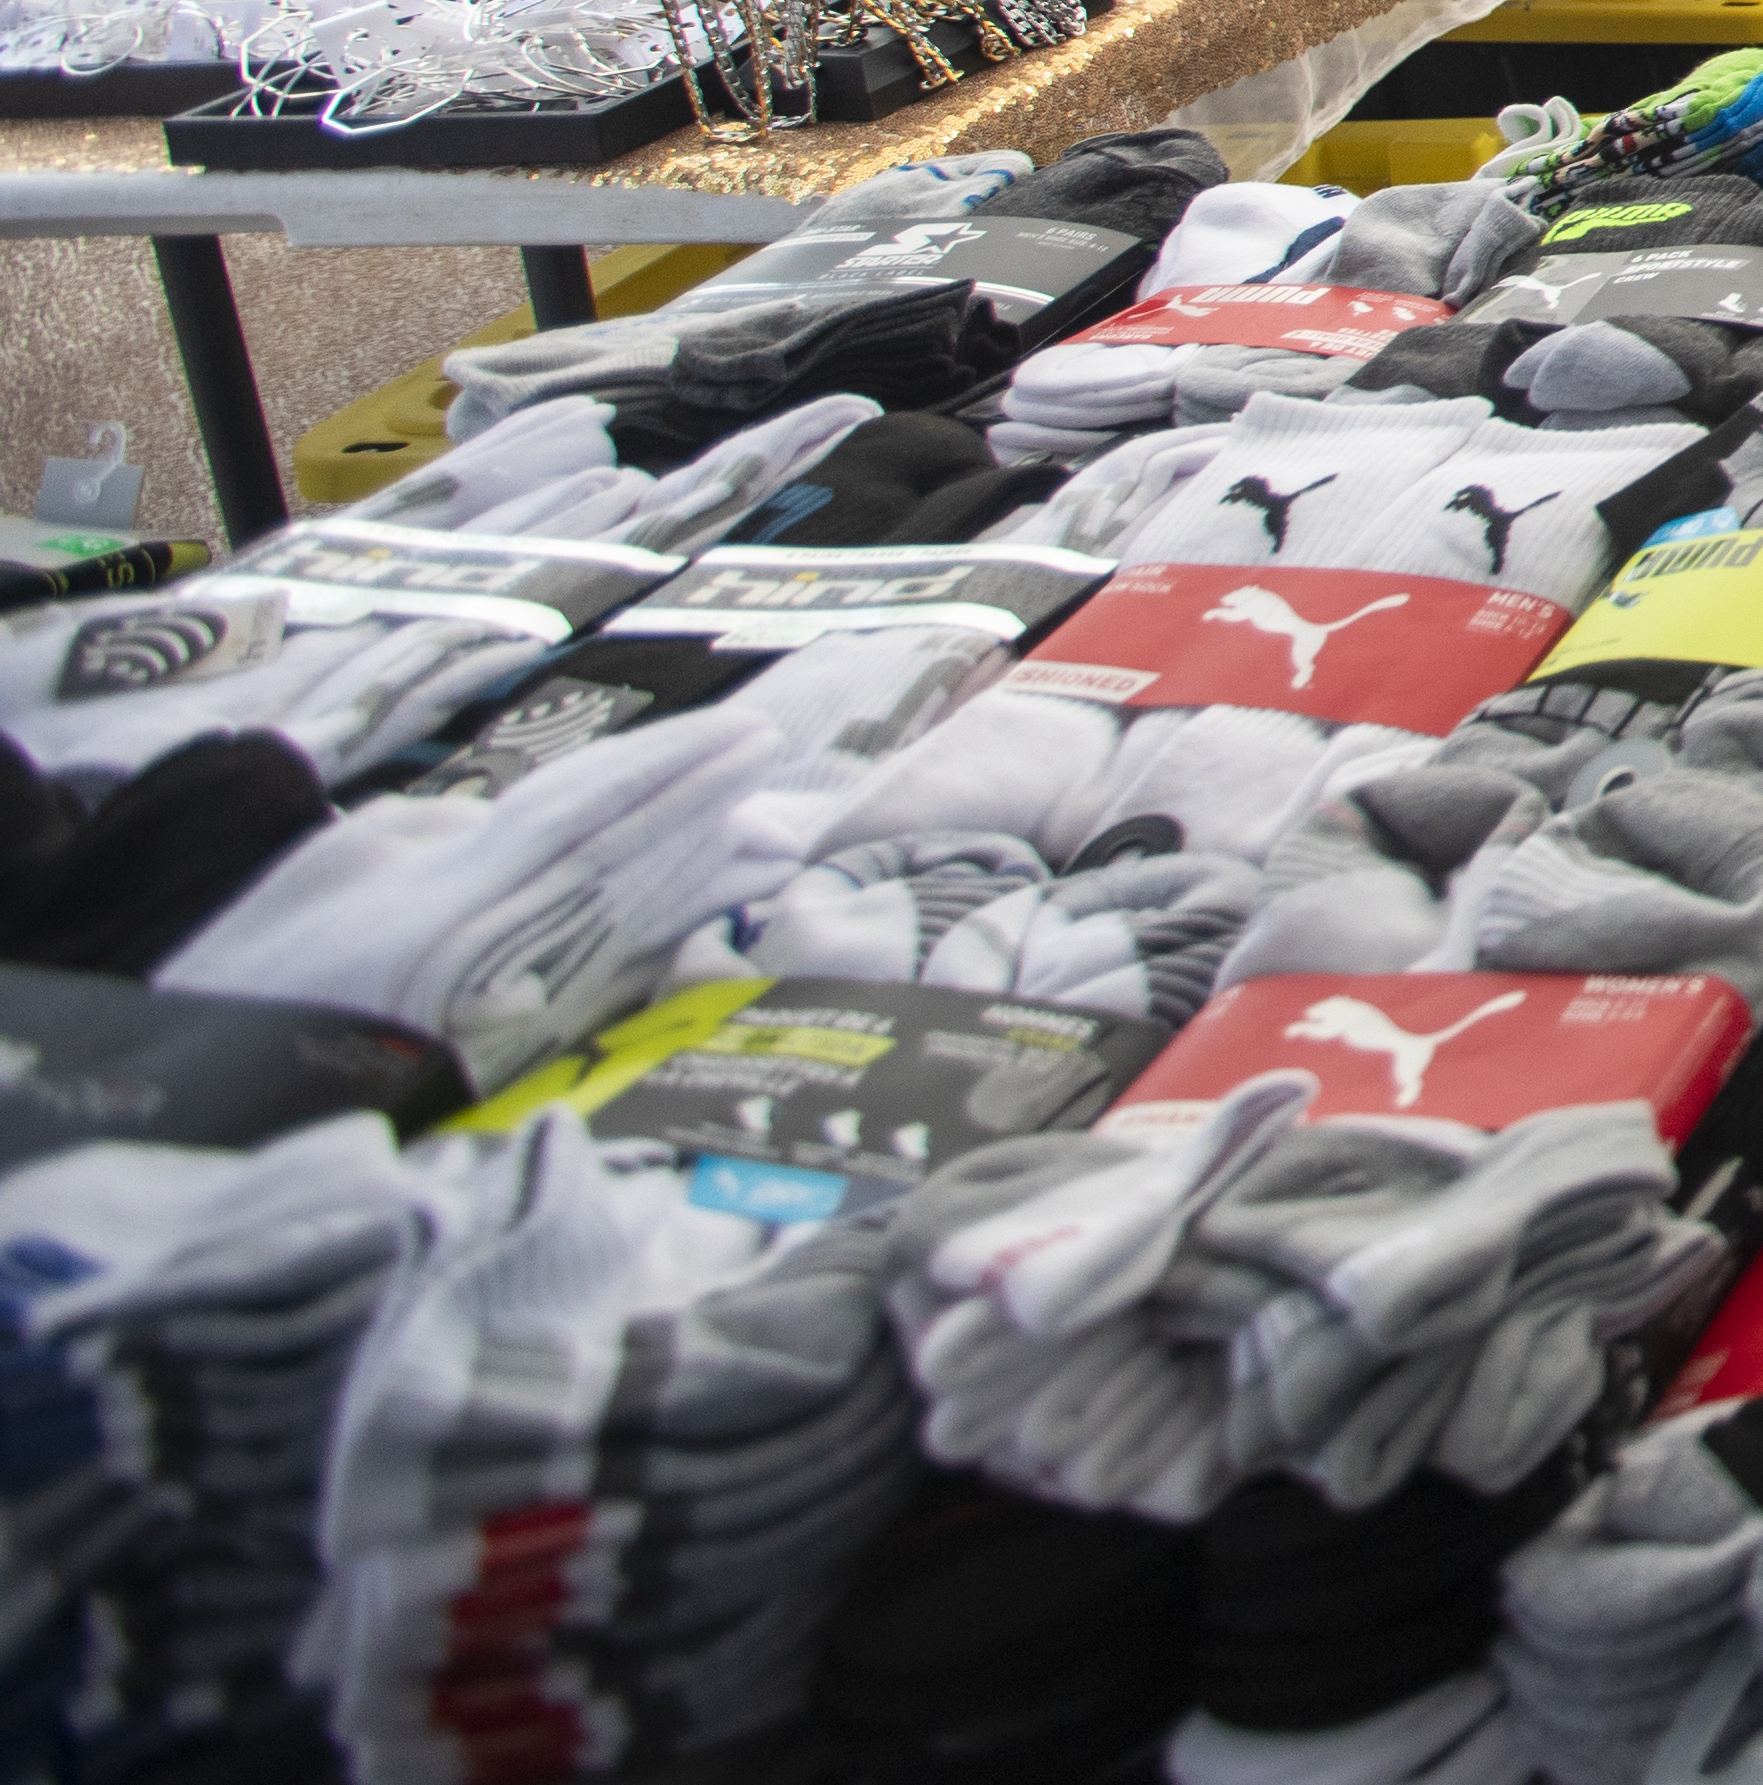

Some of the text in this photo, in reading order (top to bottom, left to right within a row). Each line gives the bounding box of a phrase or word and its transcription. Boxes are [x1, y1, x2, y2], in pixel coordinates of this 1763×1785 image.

[1056, 228, 1097, 241] PAIRS
[834, 253, 944, 269] STARTER
[1645, 249, 1693, 262] PACK
[1613, 271, 1660, 284] CREW
[1189, 285, 1332, 305] PUMA
[684, 565, 977, 606] hind
[1490, 590, 1555, 618] MEN'S
